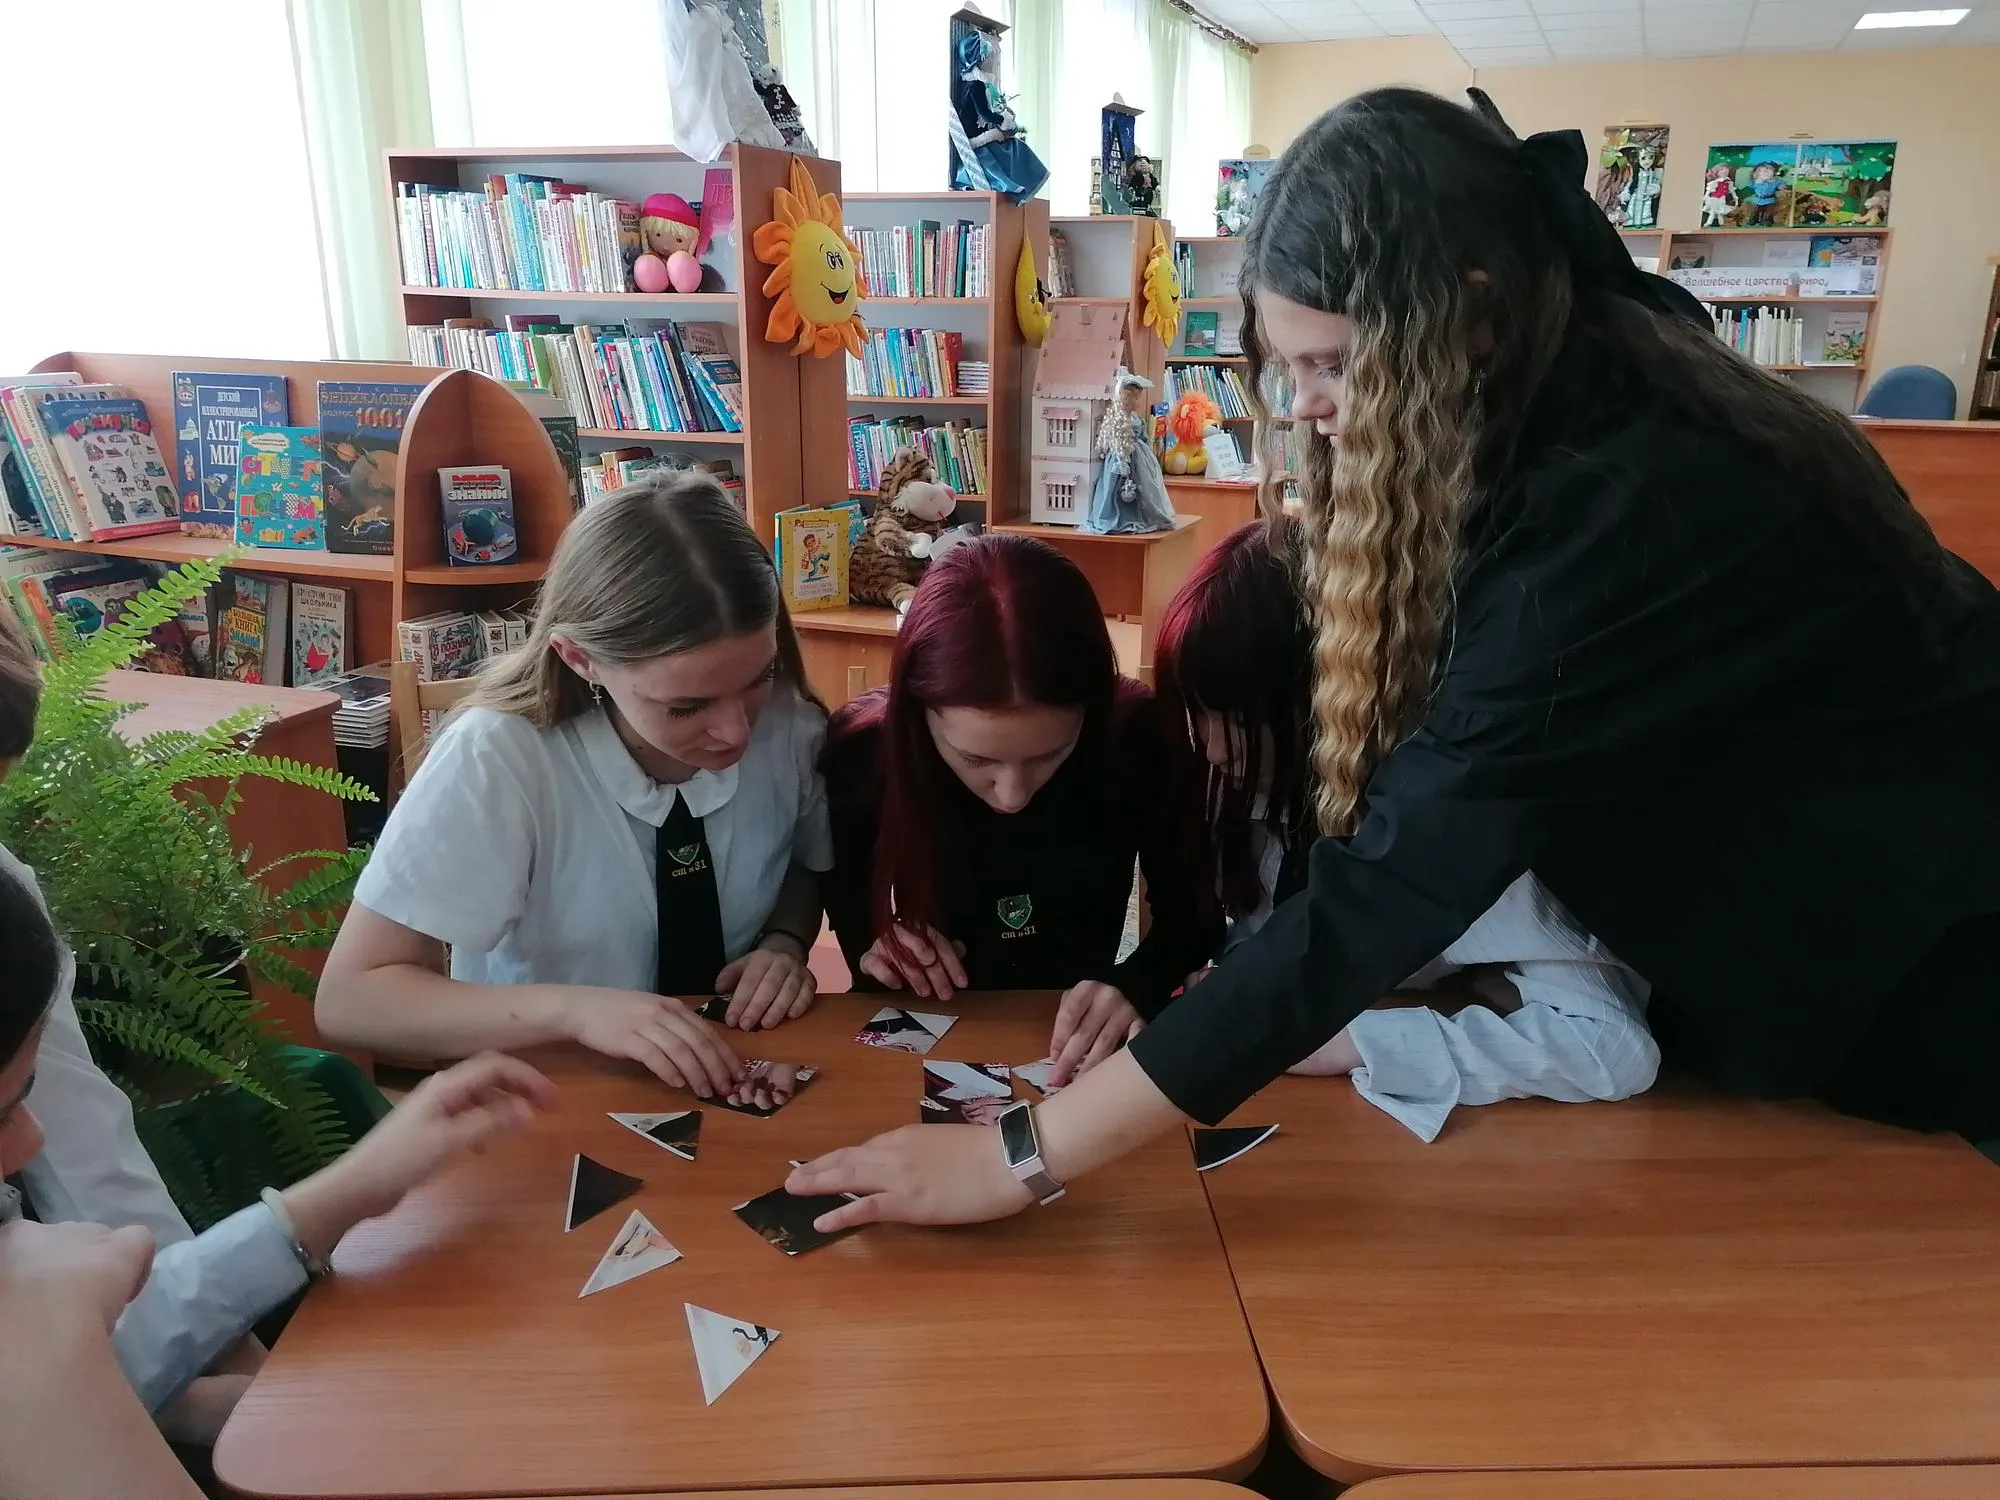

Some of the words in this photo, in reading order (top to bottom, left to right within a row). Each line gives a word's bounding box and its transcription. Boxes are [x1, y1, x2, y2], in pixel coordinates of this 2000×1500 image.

[355, 407, 404, 428] 1001
[207, 419, 255, 441] АТЛ
[452, 474, 501, 490] МИР
